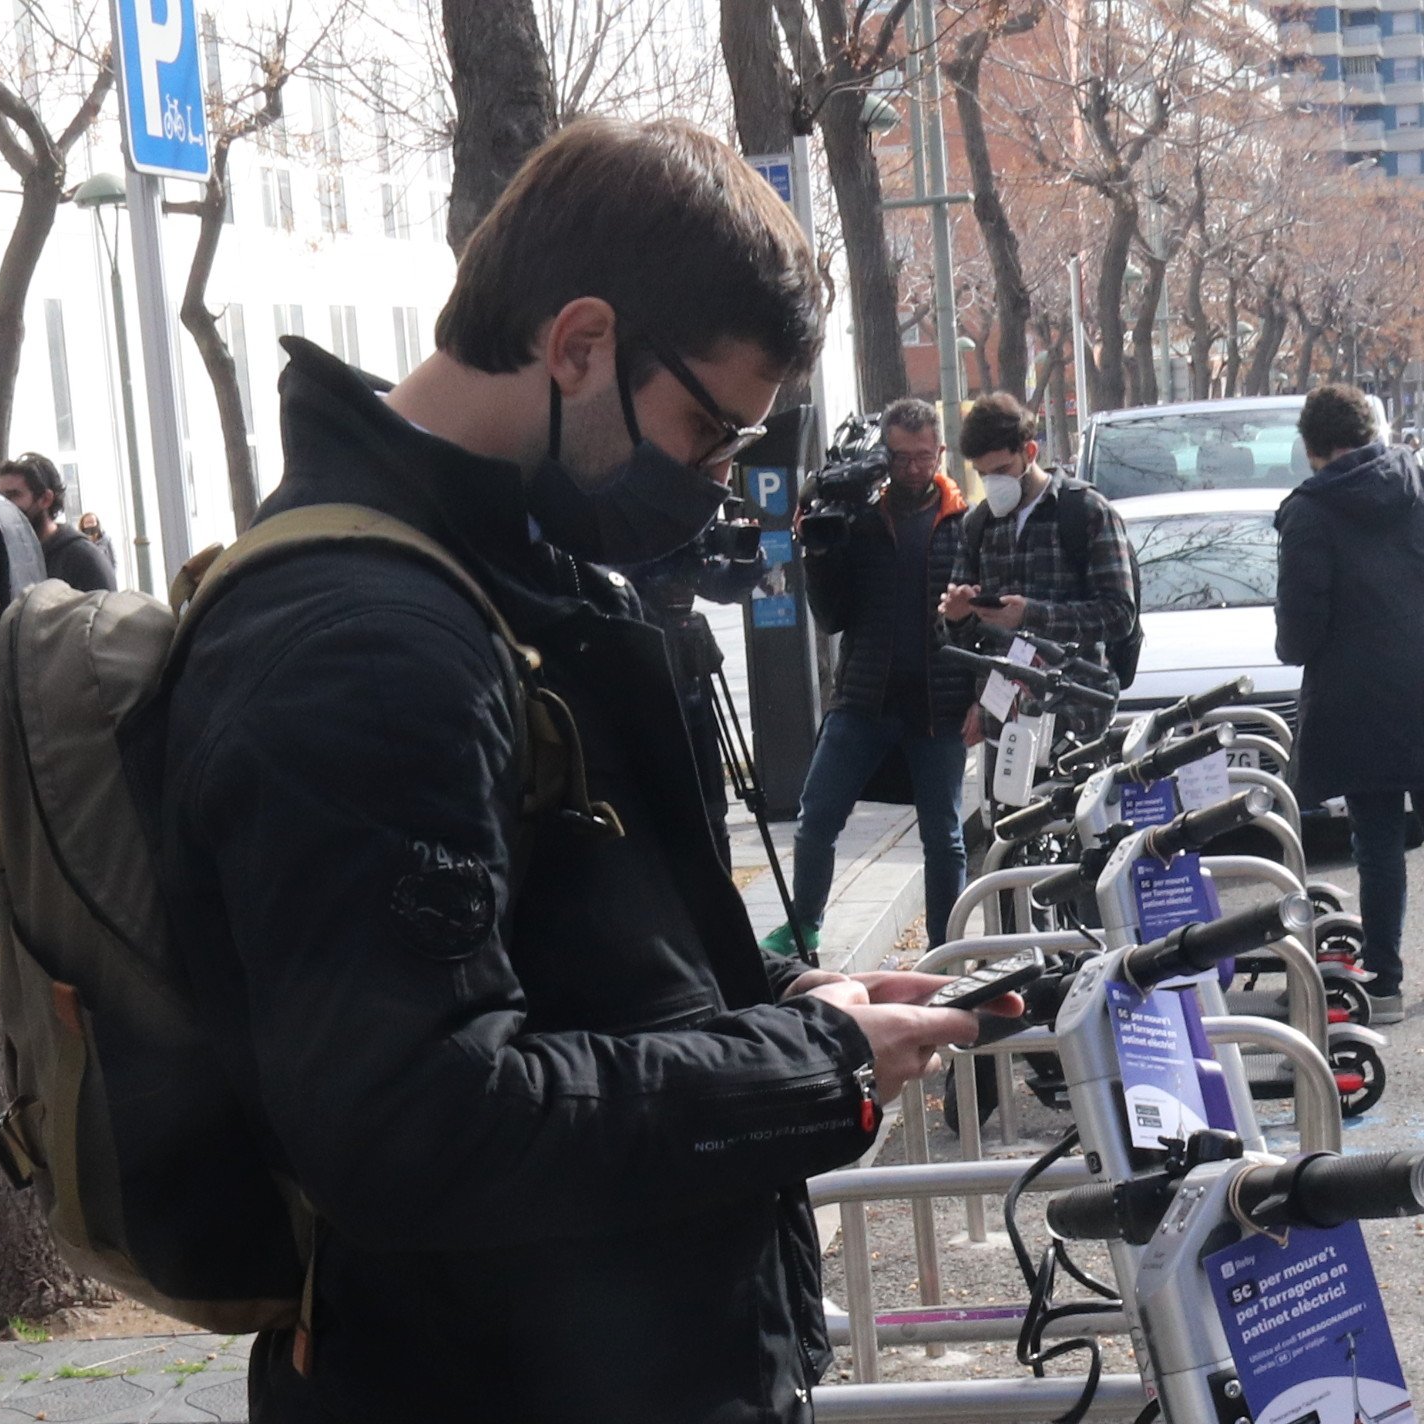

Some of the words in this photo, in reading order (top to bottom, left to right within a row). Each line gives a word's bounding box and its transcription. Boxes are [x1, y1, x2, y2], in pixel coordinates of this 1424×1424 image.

[134, 0, 183, 138] P
[758, 472, 781, 508] P
[1003, 733, 1017, 776] BIRD
[1231, 1284, 1253, 1304] 5€
[1258, 1272, 1282, 1294] per
[1282, 1246, 1337, 1280] moure't
[1235, 1302, 1259, 1326] per
[1259, 1271, 1329, 1312] Tarragona
[1329, 1262, 1348, 1279] en
[1241, 1308, 1291, 1345] patinet
[1290, 1282, 1347, 1319] elèctric!
